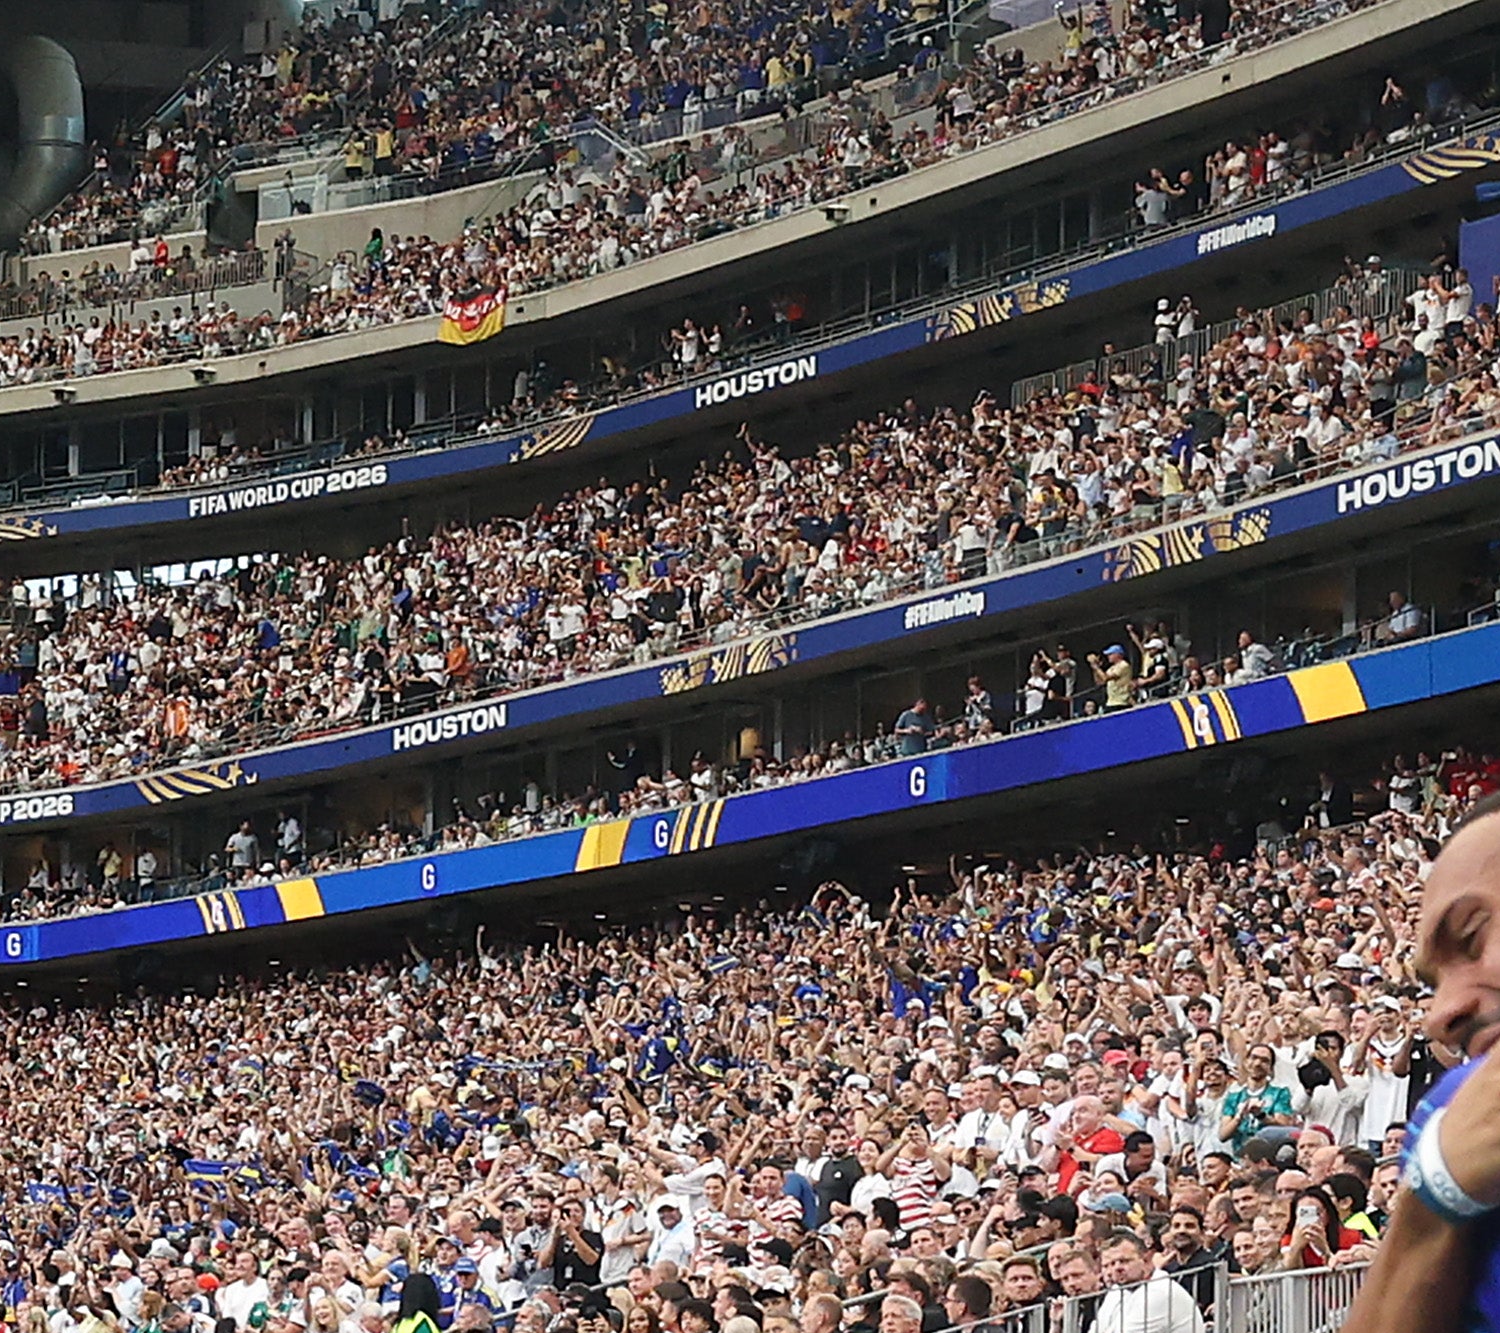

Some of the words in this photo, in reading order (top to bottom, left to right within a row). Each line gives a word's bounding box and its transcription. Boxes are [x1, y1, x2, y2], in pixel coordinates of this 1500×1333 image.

[695, 356, 817, 408] HOUSTON
[189, 496, 228, 517] FIFA
[228, 482, 288, 510] WORLD
[290, 477, 325, 498] CUP
[326, 465, 387, 493] 2026
[393, 704, 506, 750] HOUSTON
[910, 766, 926, 796] G
[12, 795, 74, 820] 2026
[655, 821, 668, 848] G
[422, 863, 435, 890] G
[6, 933, 21, 957] G
